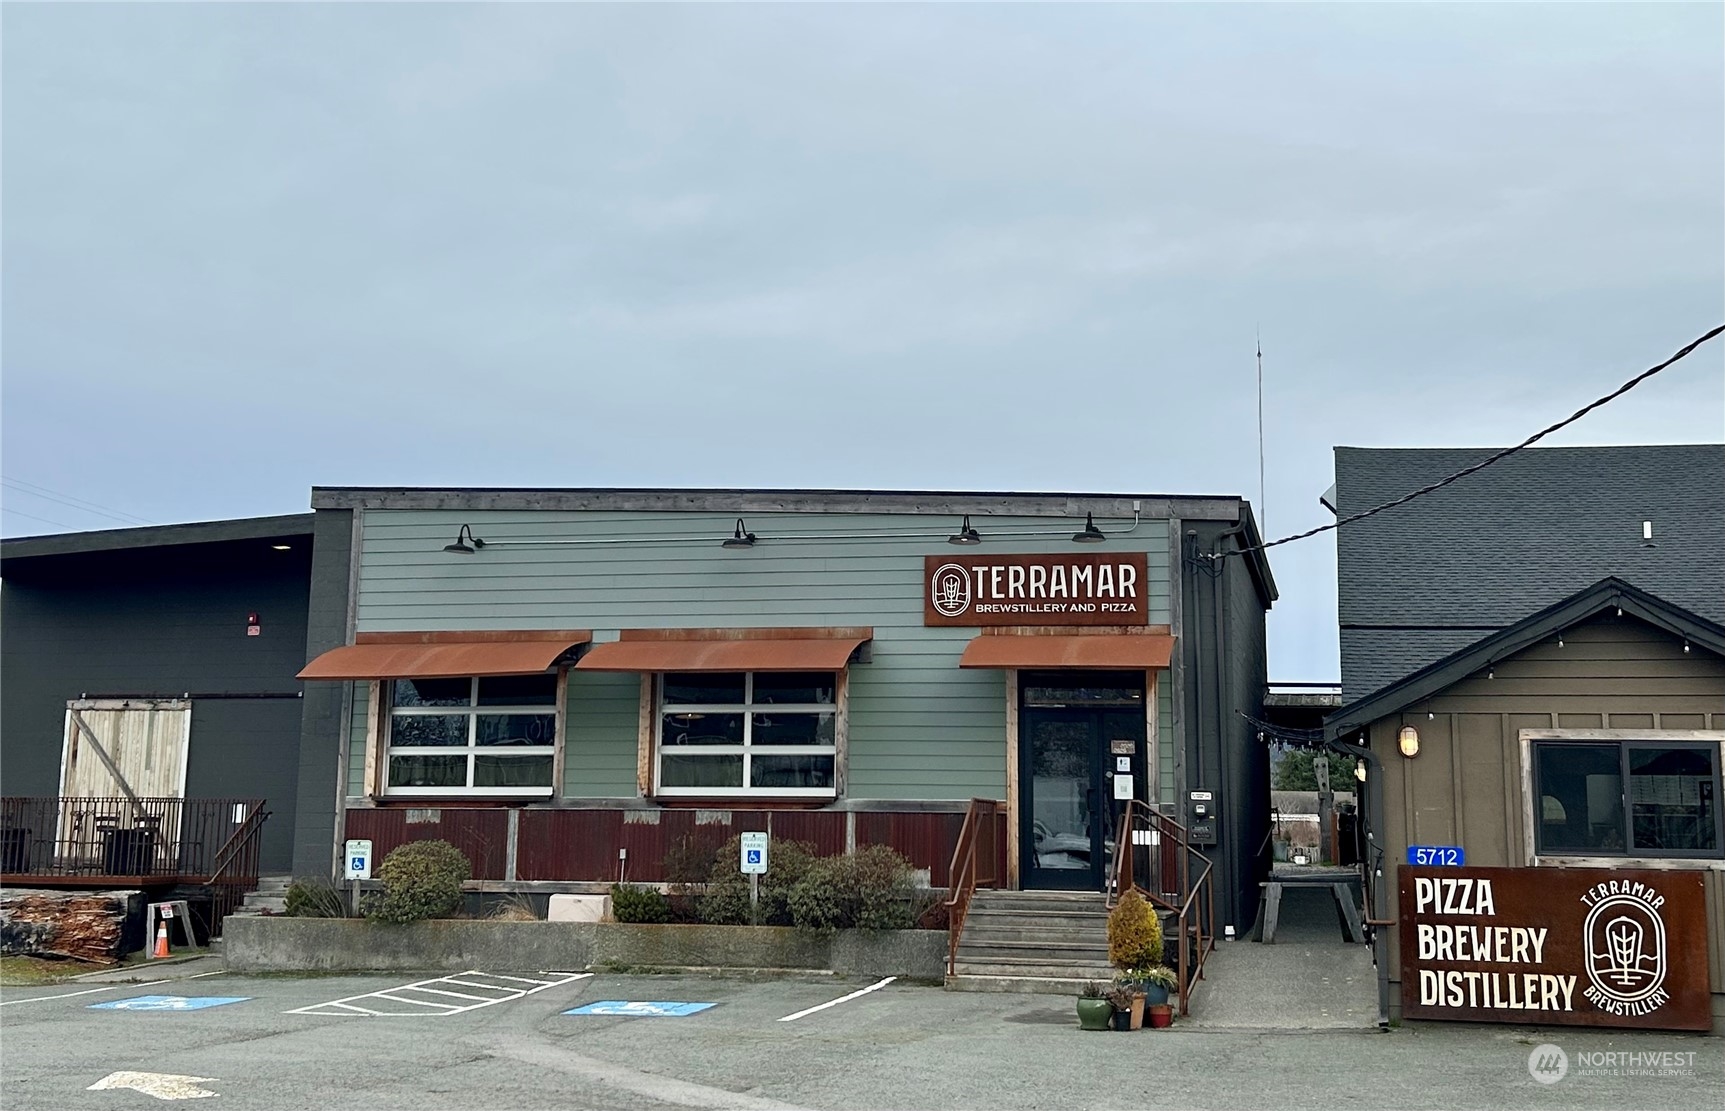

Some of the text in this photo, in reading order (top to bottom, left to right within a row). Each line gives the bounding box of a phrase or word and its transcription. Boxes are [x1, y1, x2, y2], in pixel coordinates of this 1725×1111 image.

[971, 564, 1137, 599] TERRAMAR
[975, 602, 1137, 613] BREWSTILLERY AND PIZZA
[1416, 848, 1458, 866] 5712
[1414, 877, 1496, 916] PIZZA
[1580, 879, 1665, 910] TERRAMAR
[1417, 924, 1548, 964] BREWERY
[1419, 969, 1578, 1012] DISTILLERY
[1583, 984, 1671, 1017] BREWSTILLERY
